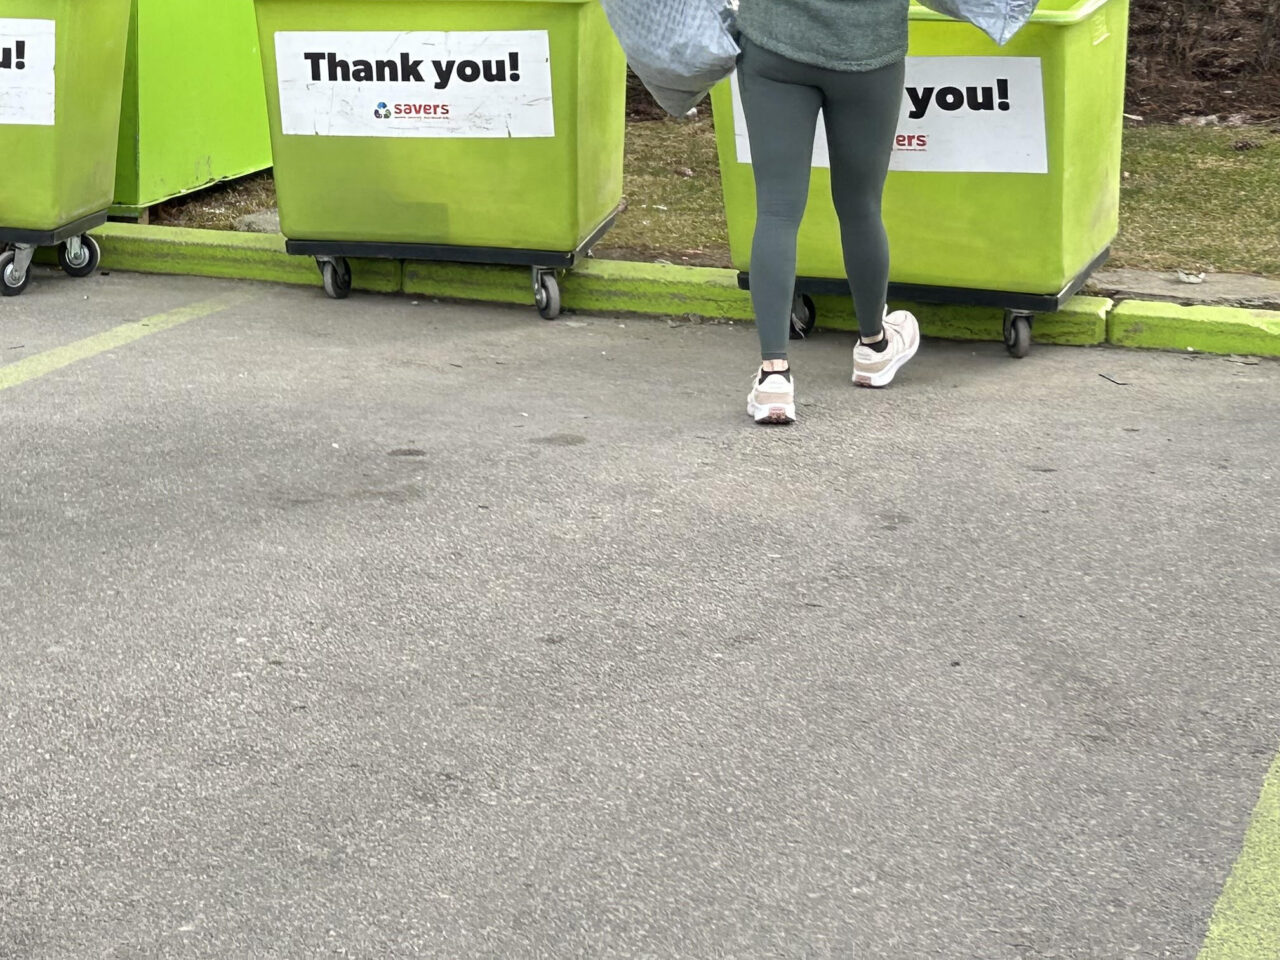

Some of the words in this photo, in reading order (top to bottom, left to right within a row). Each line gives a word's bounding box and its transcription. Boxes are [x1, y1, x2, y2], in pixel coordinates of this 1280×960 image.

[303, 52, 425, 82] Thank
[431, 52, 520, 89] you!
[394, 103, 450, 115] savers
[905, 78, 1010, 119] you!
[895, 134, 927, 146] ers
